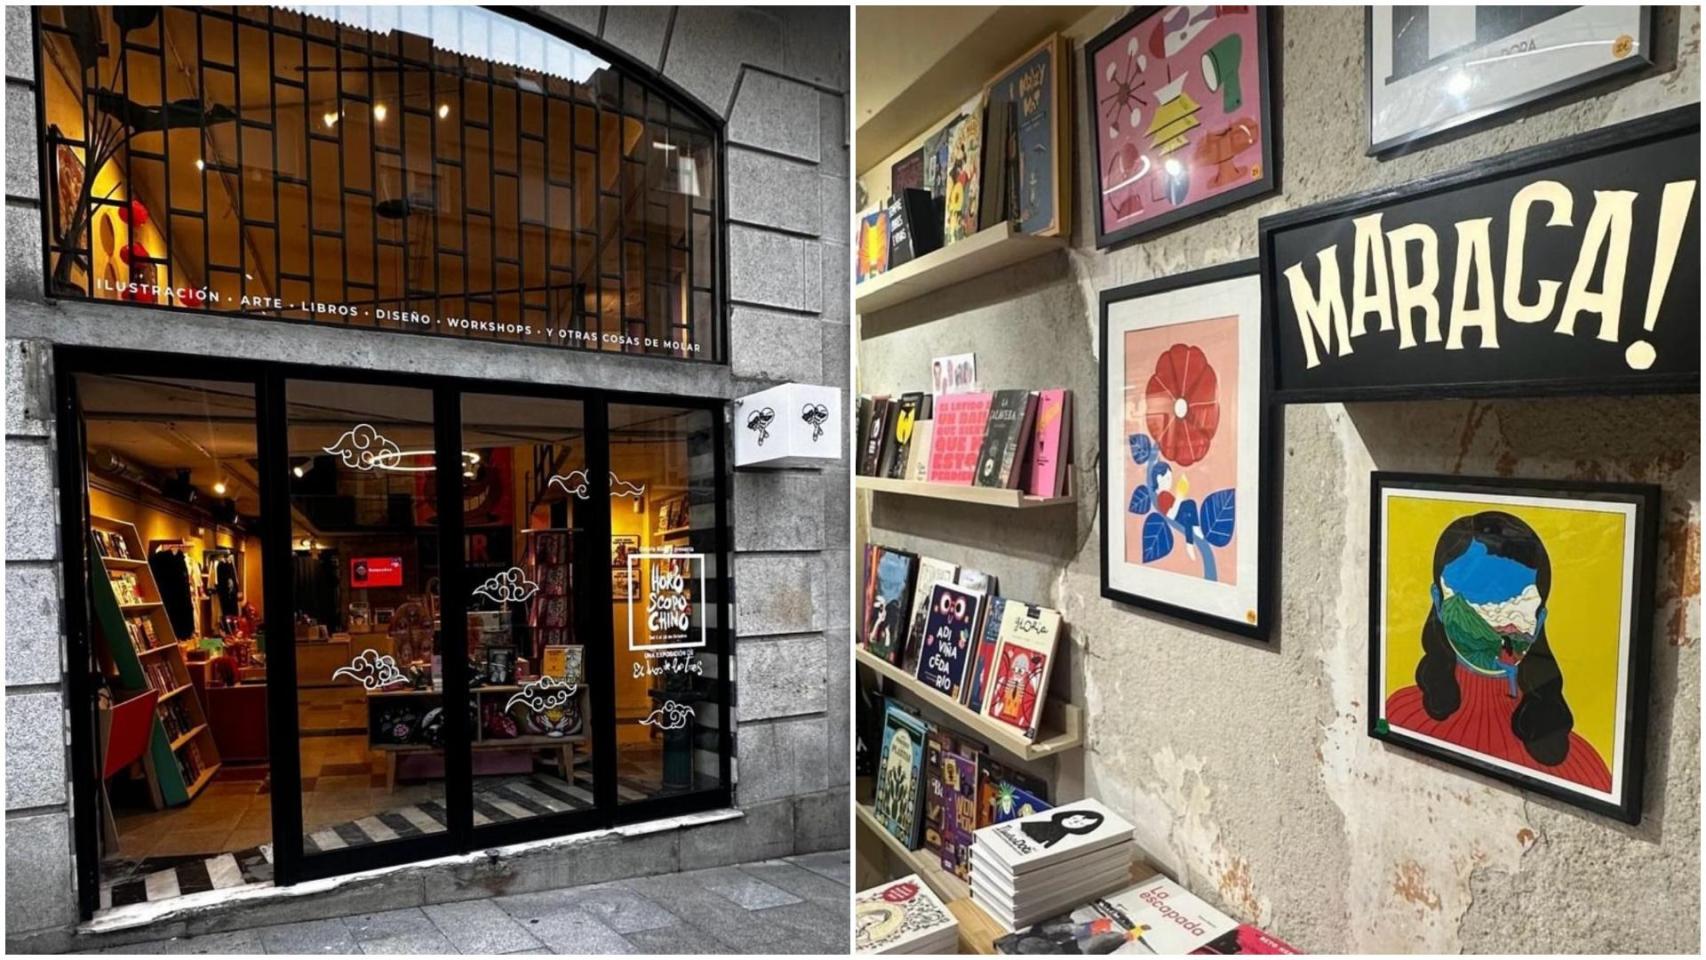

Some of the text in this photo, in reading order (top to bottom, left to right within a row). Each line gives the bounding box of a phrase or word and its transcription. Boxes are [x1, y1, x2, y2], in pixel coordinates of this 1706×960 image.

[1283, 180, 1697, 370] MARACA!
[96, 278, 701, 353] ILUSTRACIÓN ARTE LIBROS DISEÑO WORKSHOPS Y OTRAS COSAS DE MOLAR
[935, 437, 966, 453] QUE
[647, 591, 687, 614] SCOPO
[647, 610, 689, 632] CHINO
[936, 625, 952, 641] ADI
[938, 640, 957, 660] VIÑA
[928, 653, 950, 675] CEDA
[935, 674, 952, 690] RÍO
[1150, 885, 1171, 901] La
[1139, 890, 1206, 938] escapada
